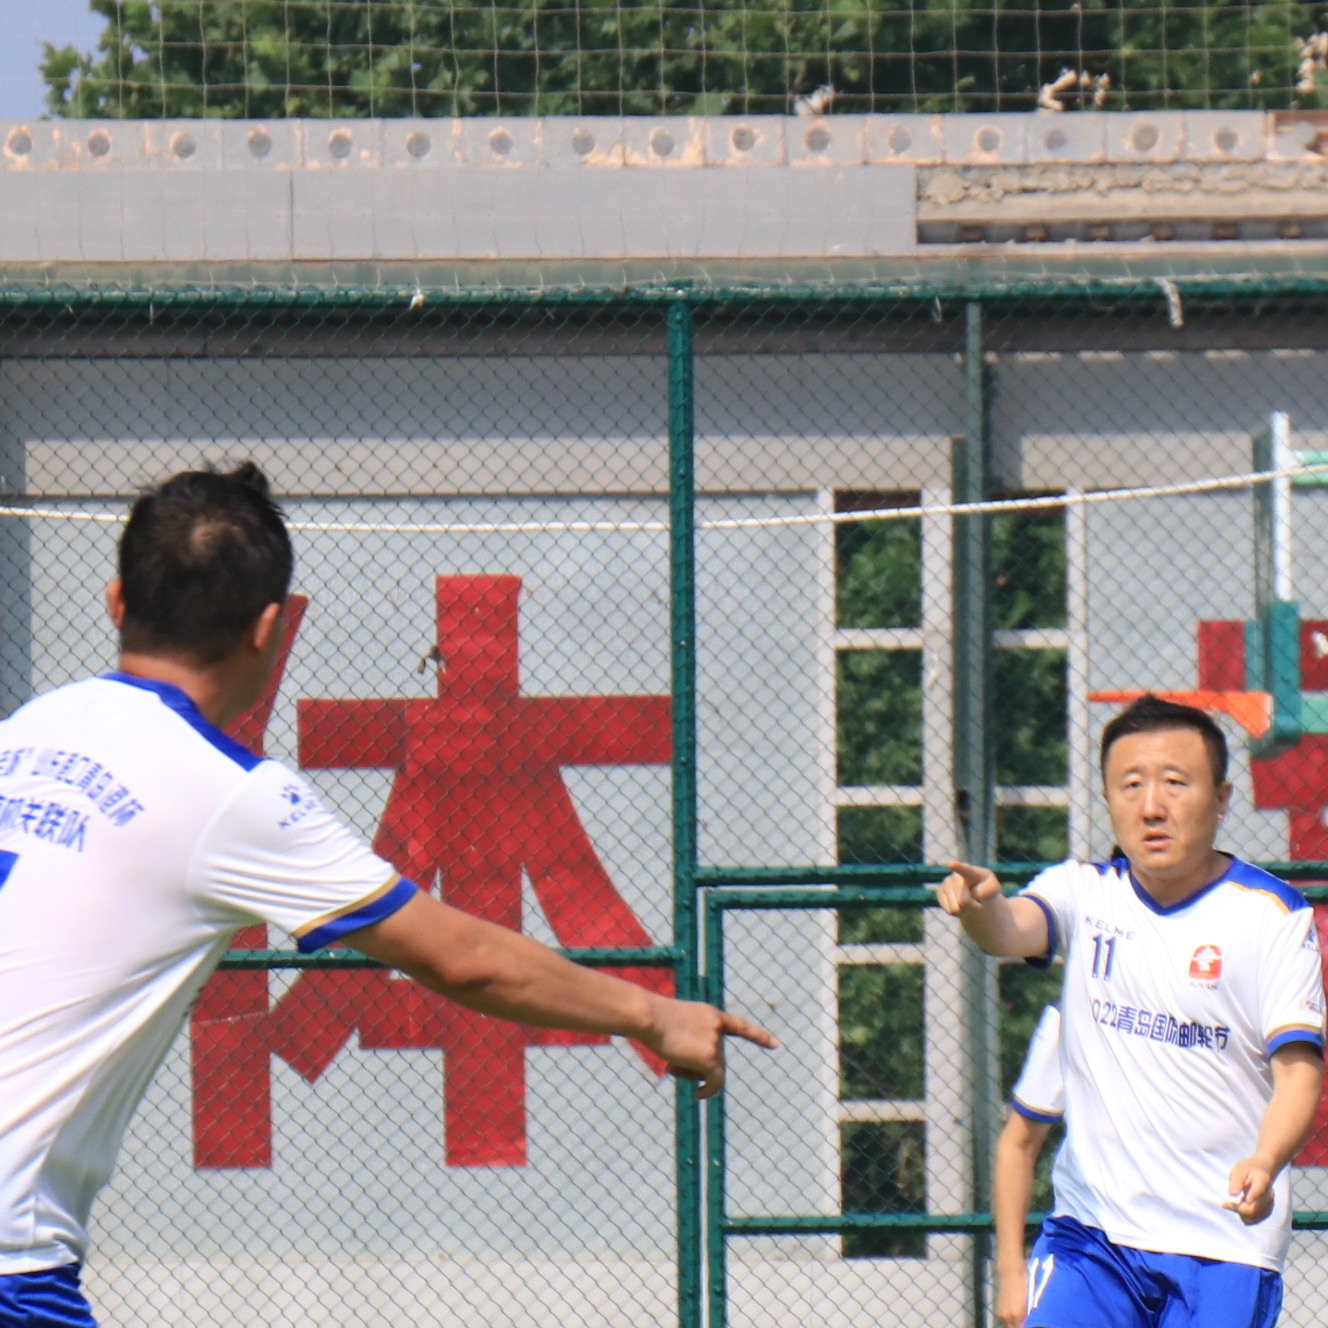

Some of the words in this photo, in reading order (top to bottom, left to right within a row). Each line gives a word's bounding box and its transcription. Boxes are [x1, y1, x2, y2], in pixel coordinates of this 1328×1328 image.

[1085, 915, 1135, 940] KELME
[1092, 933, 1116, 982] 11
[1091, 998, 1231, 1052] 022青岛国际邮轮节
